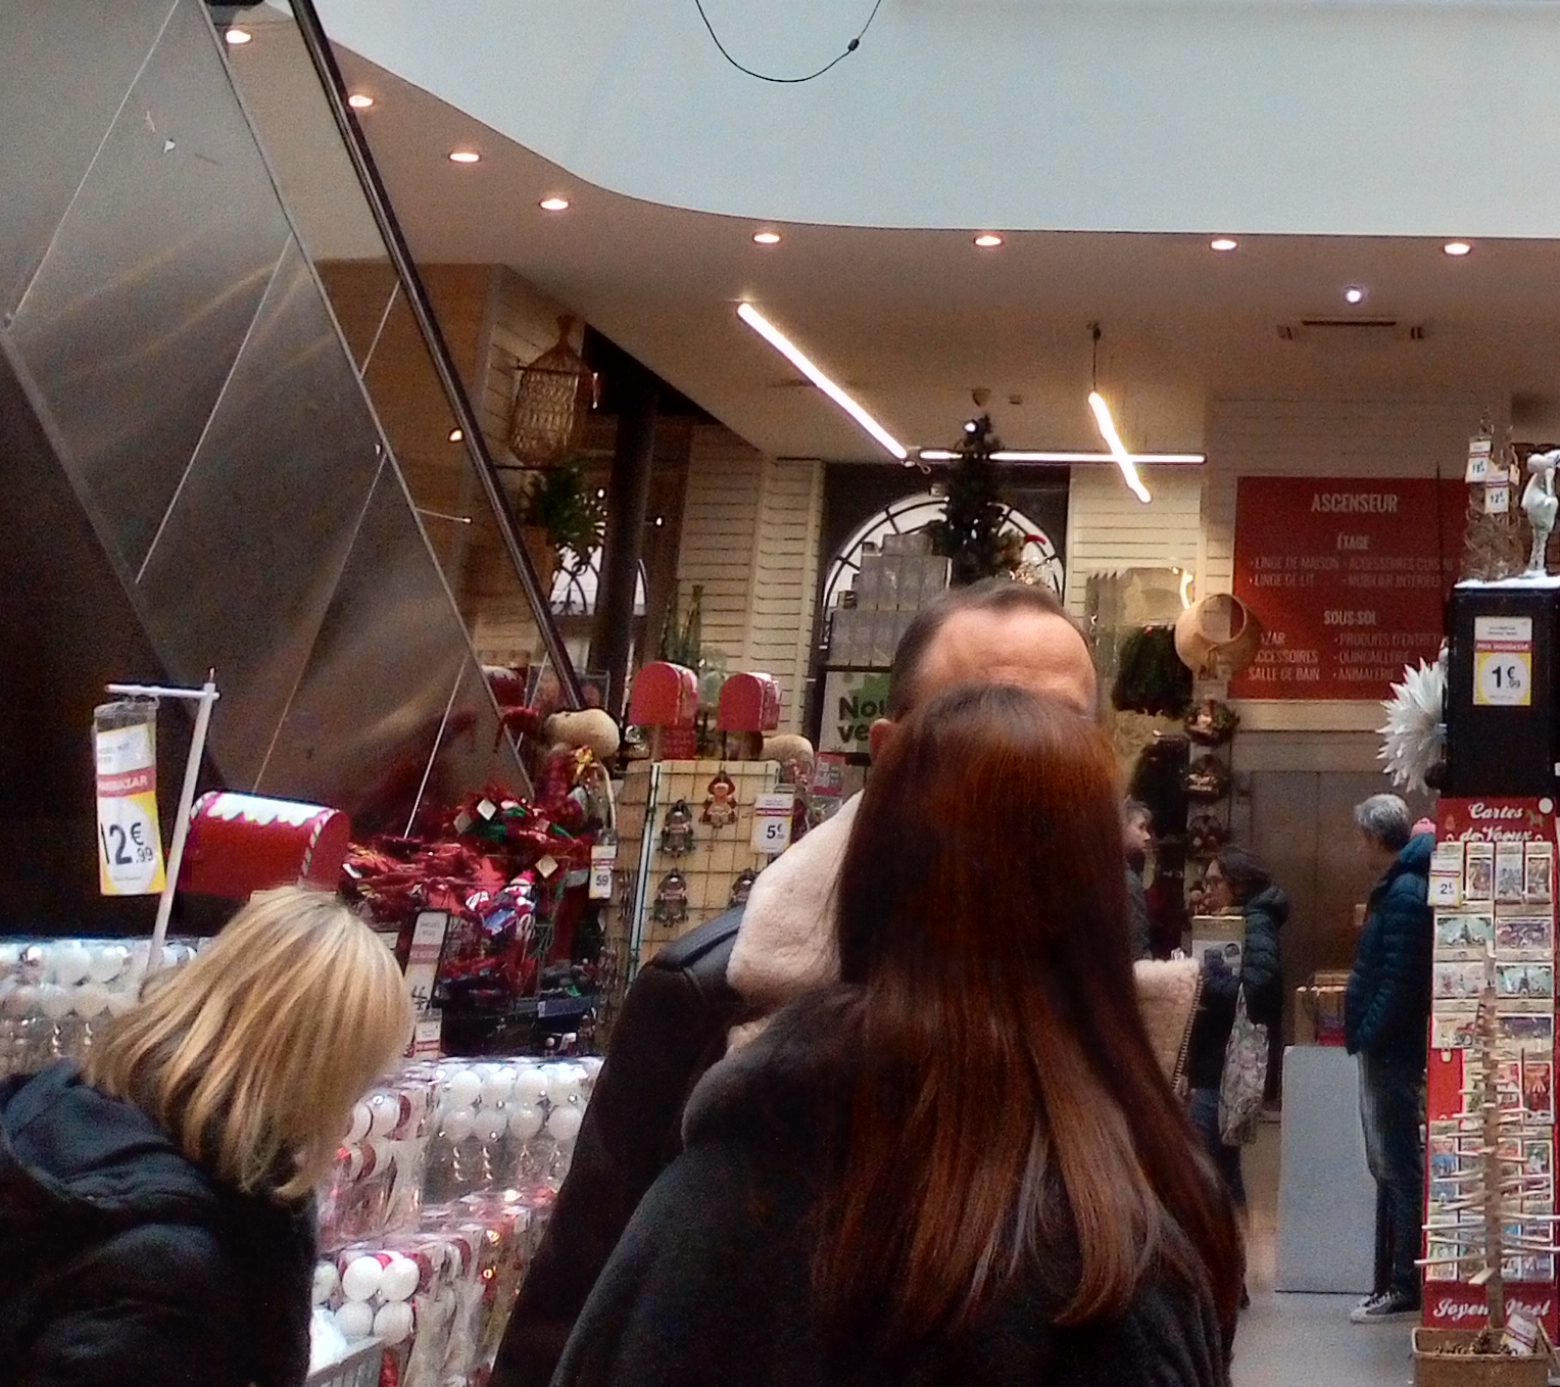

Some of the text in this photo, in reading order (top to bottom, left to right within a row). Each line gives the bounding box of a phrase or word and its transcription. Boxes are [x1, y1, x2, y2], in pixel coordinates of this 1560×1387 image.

[1311, 493, 1399, 513] ASCENSEUR
[1337, 532, 1370, 550] ÉTAGE
[1492, 666, 1501, 688] 1
[1468, 802, 1524, 819] Cartes
[766, 825, 776, 839] 5
[101, 822, 132, 865] 12
[130, 822, 143, 846] €
[1433, 1298, 1489, 1322] Joyeu
